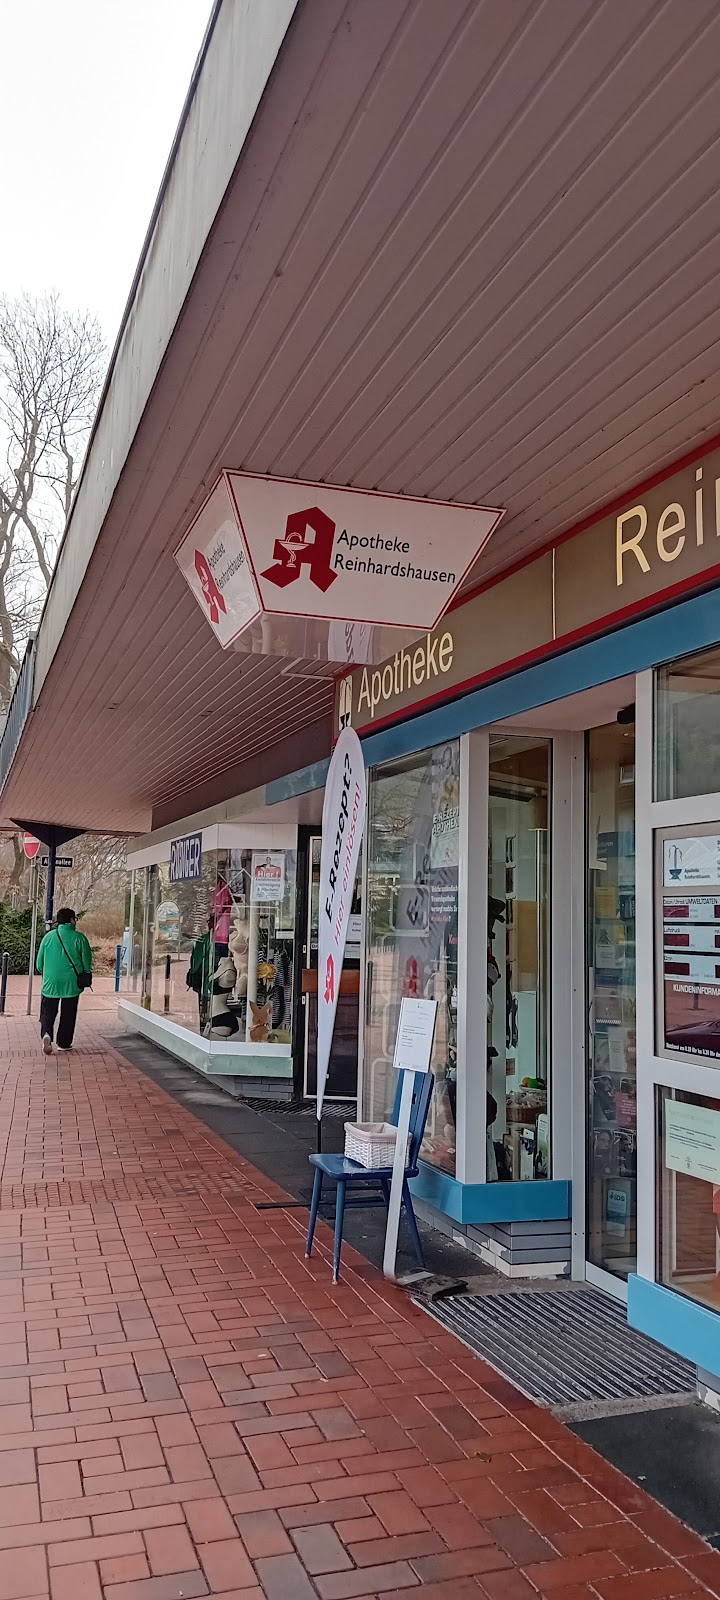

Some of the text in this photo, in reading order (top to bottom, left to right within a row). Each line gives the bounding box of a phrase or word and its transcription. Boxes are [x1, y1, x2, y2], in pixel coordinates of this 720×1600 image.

[334, 553, 456, 584] Reinhardshausen
[337, 529, 410, 553] Apotheke
[617, 467, 720, 586] Rei
[357, 632, 454, 718] Apotheke
[325, 753, 352, 924] E-Rezept?
